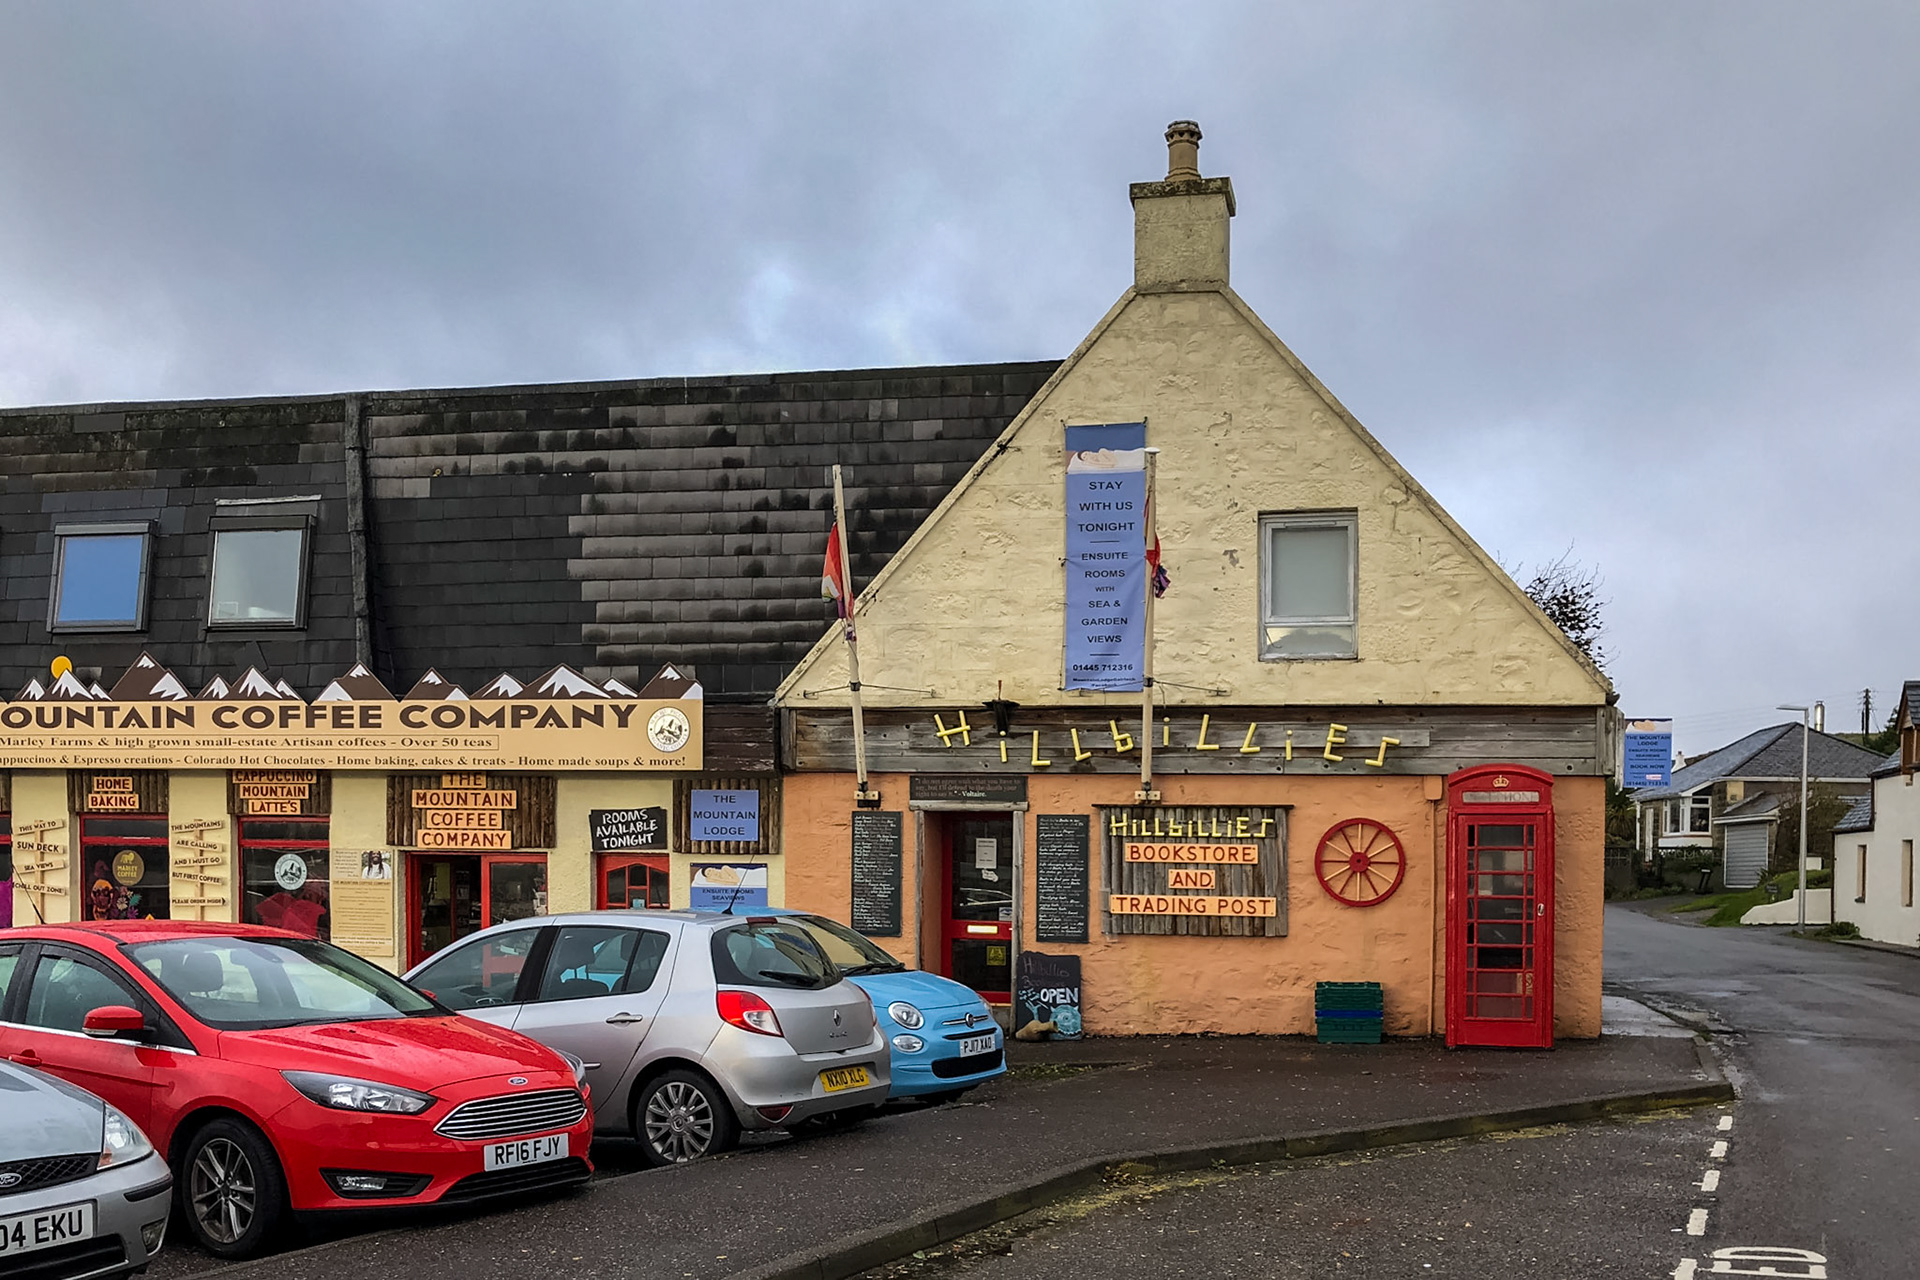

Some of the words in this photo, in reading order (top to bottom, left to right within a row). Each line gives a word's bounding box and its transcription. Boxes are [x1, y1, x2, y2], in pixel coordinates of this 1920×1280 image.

[1089, 481, 1123, 491] STAY
[1079, 501, 1114, 511] WITH
[1116, 501, 1133, 511] US
[1078, 521, 1135, 532] TONIGHT
[1081, 552, 1129, 561] ENSUITE
[1085, 569, 1126, 578] ROOMS
[1089, 600, 1111, 609] SEA
[1113, 600, 1121, 608] &
[1081, 617, 1128, 626] GARDEN
[1087, 634, 1123, 643] VIEWS
[1072, 663, 1100, 672] 01445
[1101, 663, 1133, 672] 712316
[212, 705, 382, 729] COFFEE
[399, 704, 638, 729] COMPANY
[0, 737, 46, 749] Marley
[51, 737, 93, 747] Farms
[98, 737, 110, 747] &
[115, 737, 144, 749] high
[148, 738, 191, 749] grown
[195, 737, 277, 747] small-estate
[280, 737, 333, 747] Artisan
[338, 737, 386, 747] coffees
[401, 737, 438, 747] Over
[442, 737, 459, 747] 50
[463, 738, 492, 747] teas
[60, 755, 69, 764] &
[74, 755, 121, 767] Espresso
[124, 755, 174, 765] creations
[184, 755, 236, 765] Colorado
[239, 755, 260, 765] Hot
[263, 755, 325, 765] Chocolates
[336, 755, 371, 765] Home
[375, 756, 418, 767] baking,
[422, 756, 454, 765] cakes
[457, 756, 468, 765] &
[472, 756, 506, 766] treats
[518, 756, 556, 766] Home
[558, 757, 591, 766] made
[595, 758, 630, 768] soups
[633, 757, 645, 766] &
[649, 757, 685, 766] more!
[235, 771, 314, 782] CAPPUCCINO
[446, 772, 483, 786] THE
[96, 778, 131, 790] HOME
[242, 785, 306, 797] MOUNTAIN
[90, 796, 136, 807] BAKING
[416, 792, 513, 806] MOUNTAIN
[713, 795, 736, 804] THE
[251, 801, 297, 813] LATTE'S
[431, 813, 498, 827] COFFEE
[602, 809, 649, 825] ROOMS
[693, 810, 756, 820] MOUNTAIN
[19, 825, 33, 833] THIS
[184, 821, 221, 829] MOUNTAINS
[596, 819, 659, 838] AVAILABLE
[704, 826, 745, 836] LODGE
[190, 841, 217, 850] CALLING
[422, 833, 506, 847] COMPANY
[601, 832, 655, 849] TONIGHT
[17, 841, 34, 850] SUN
[37, 844, 60, 853] DECK
[1130, 845, 1254, 862] BOOKSTORE
[199, 875, 220, 884] COFFEE
[1172, 872, 1213, 887] AND
[1116, 897, 1207, 913] TRADING
[1218, 899, 1272, 915] POST
[1040, 987, 1079, 1004] OPEN
[826, 1070, 848, 1088] NX10
[848, 1068, 865, 1083] XLG
[494, 1142, 530, 1165] RF16
[533, 1136, 560, 1159] FJY
[34, 1209, 83, 1244] EKU
